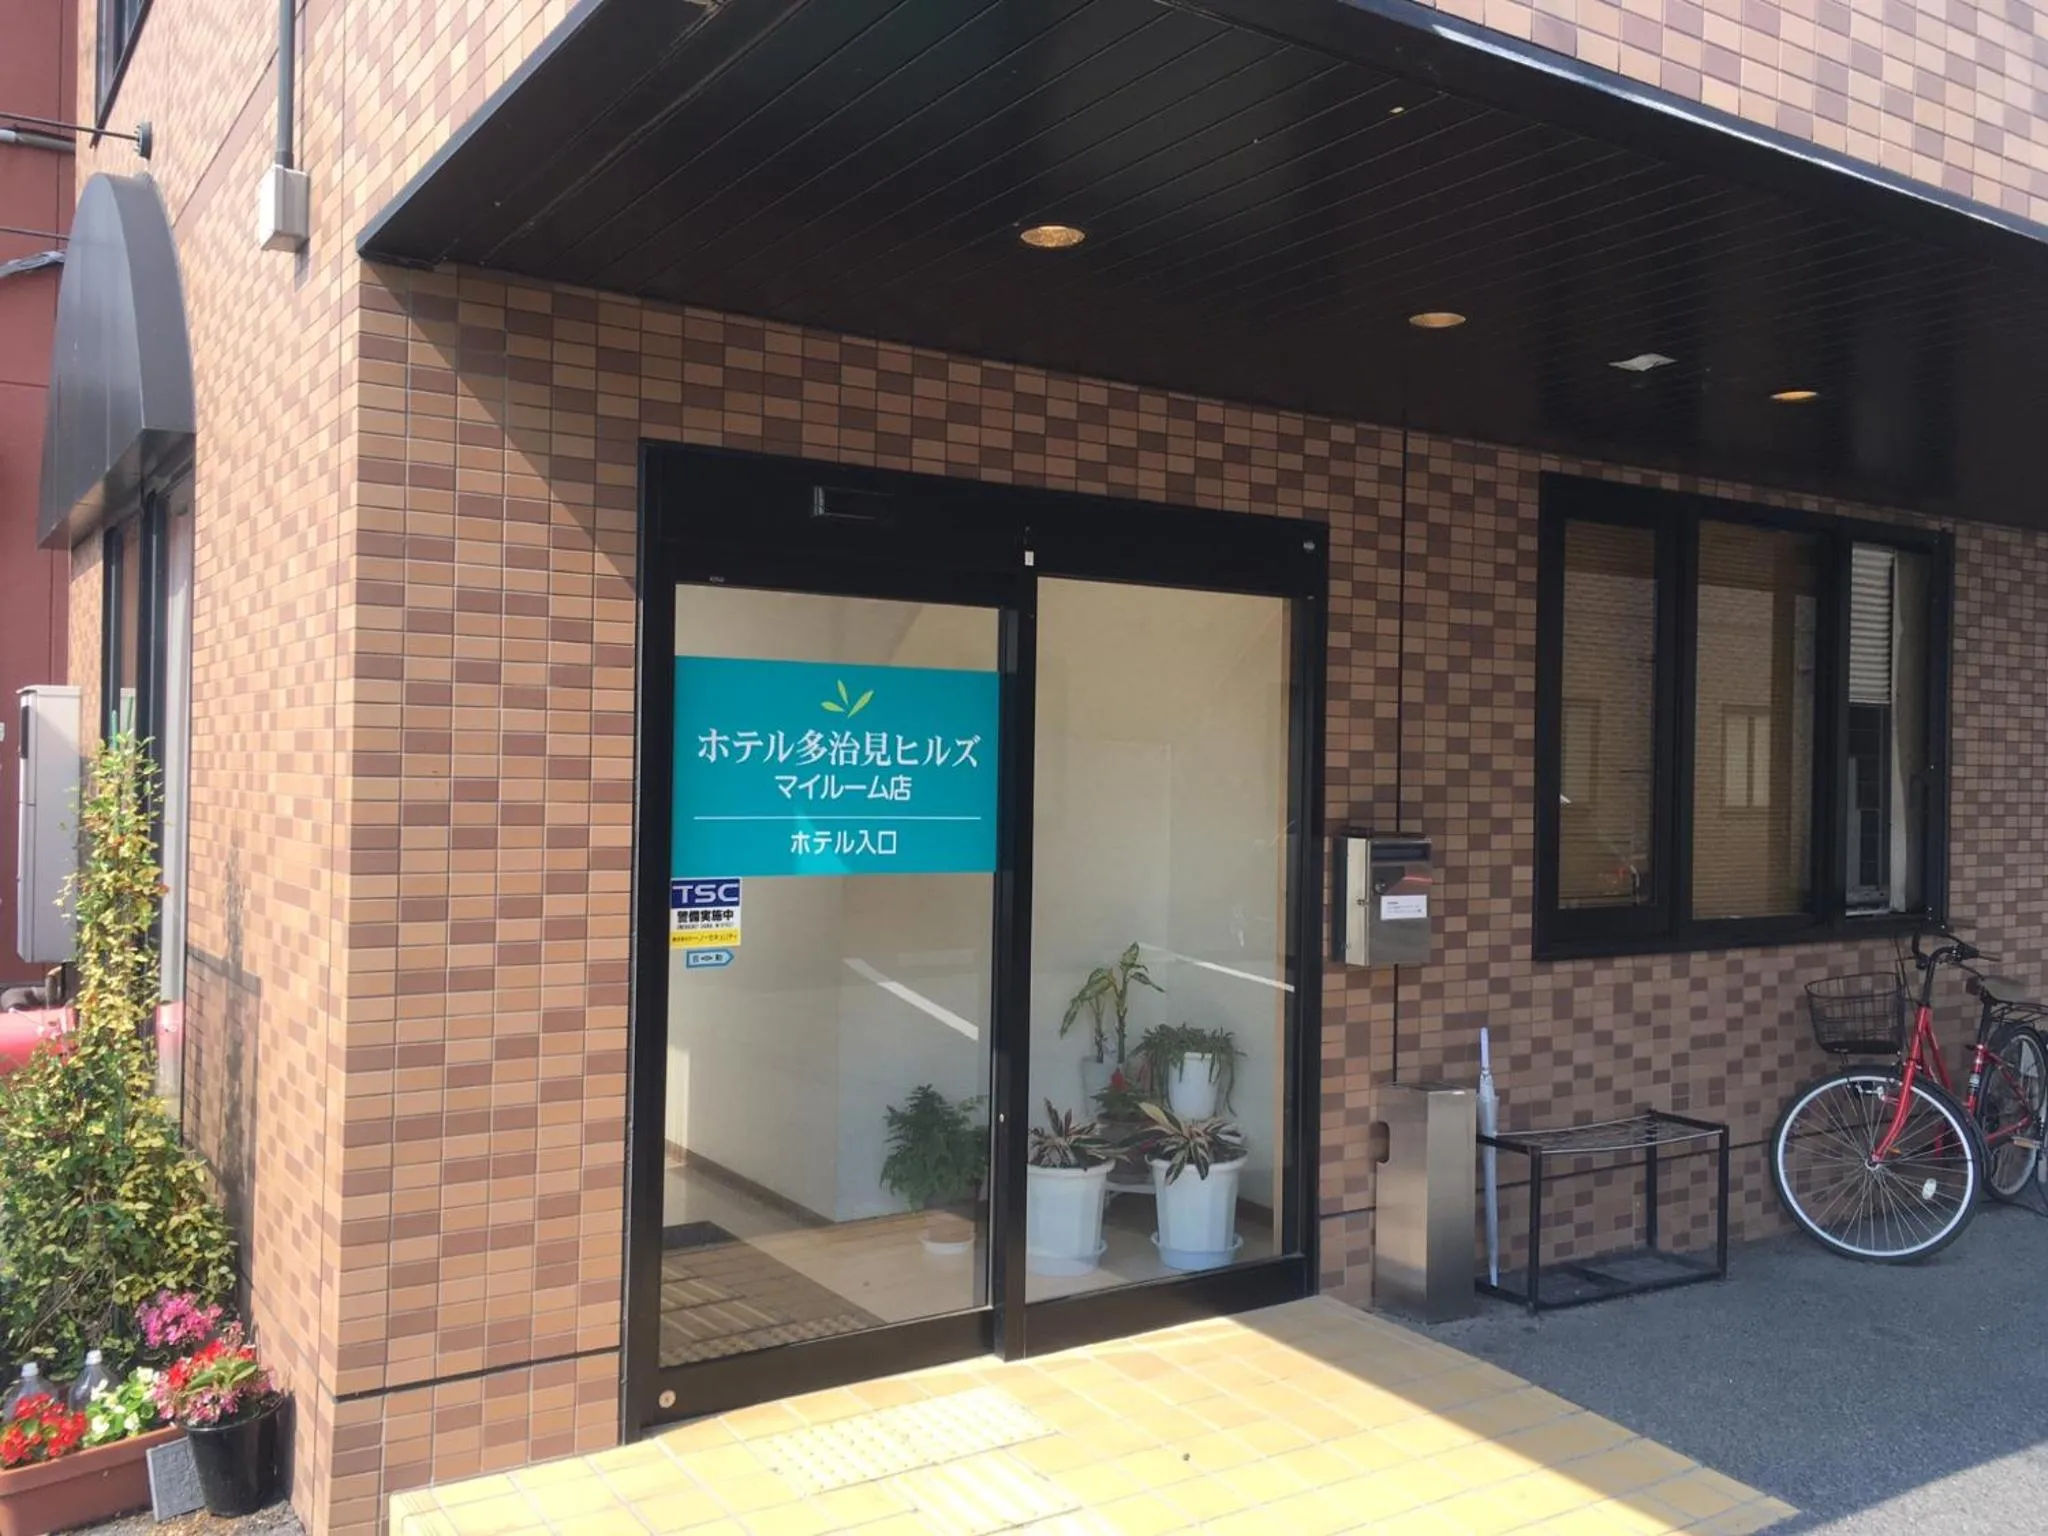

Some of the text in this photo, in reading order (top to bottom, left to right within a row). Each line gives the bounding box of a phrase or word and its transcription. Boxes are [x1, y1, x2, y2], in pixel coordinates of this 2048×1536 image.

[698, 728, 981, 768] ホテル多治見ヒルズ
[774, 774, 912, 801] マイルーム店
[790, 830, 897, 855] ホテル入口
[672, 883, 738, 904] TSC
[677, 909, 734, 924] 警備実施中
